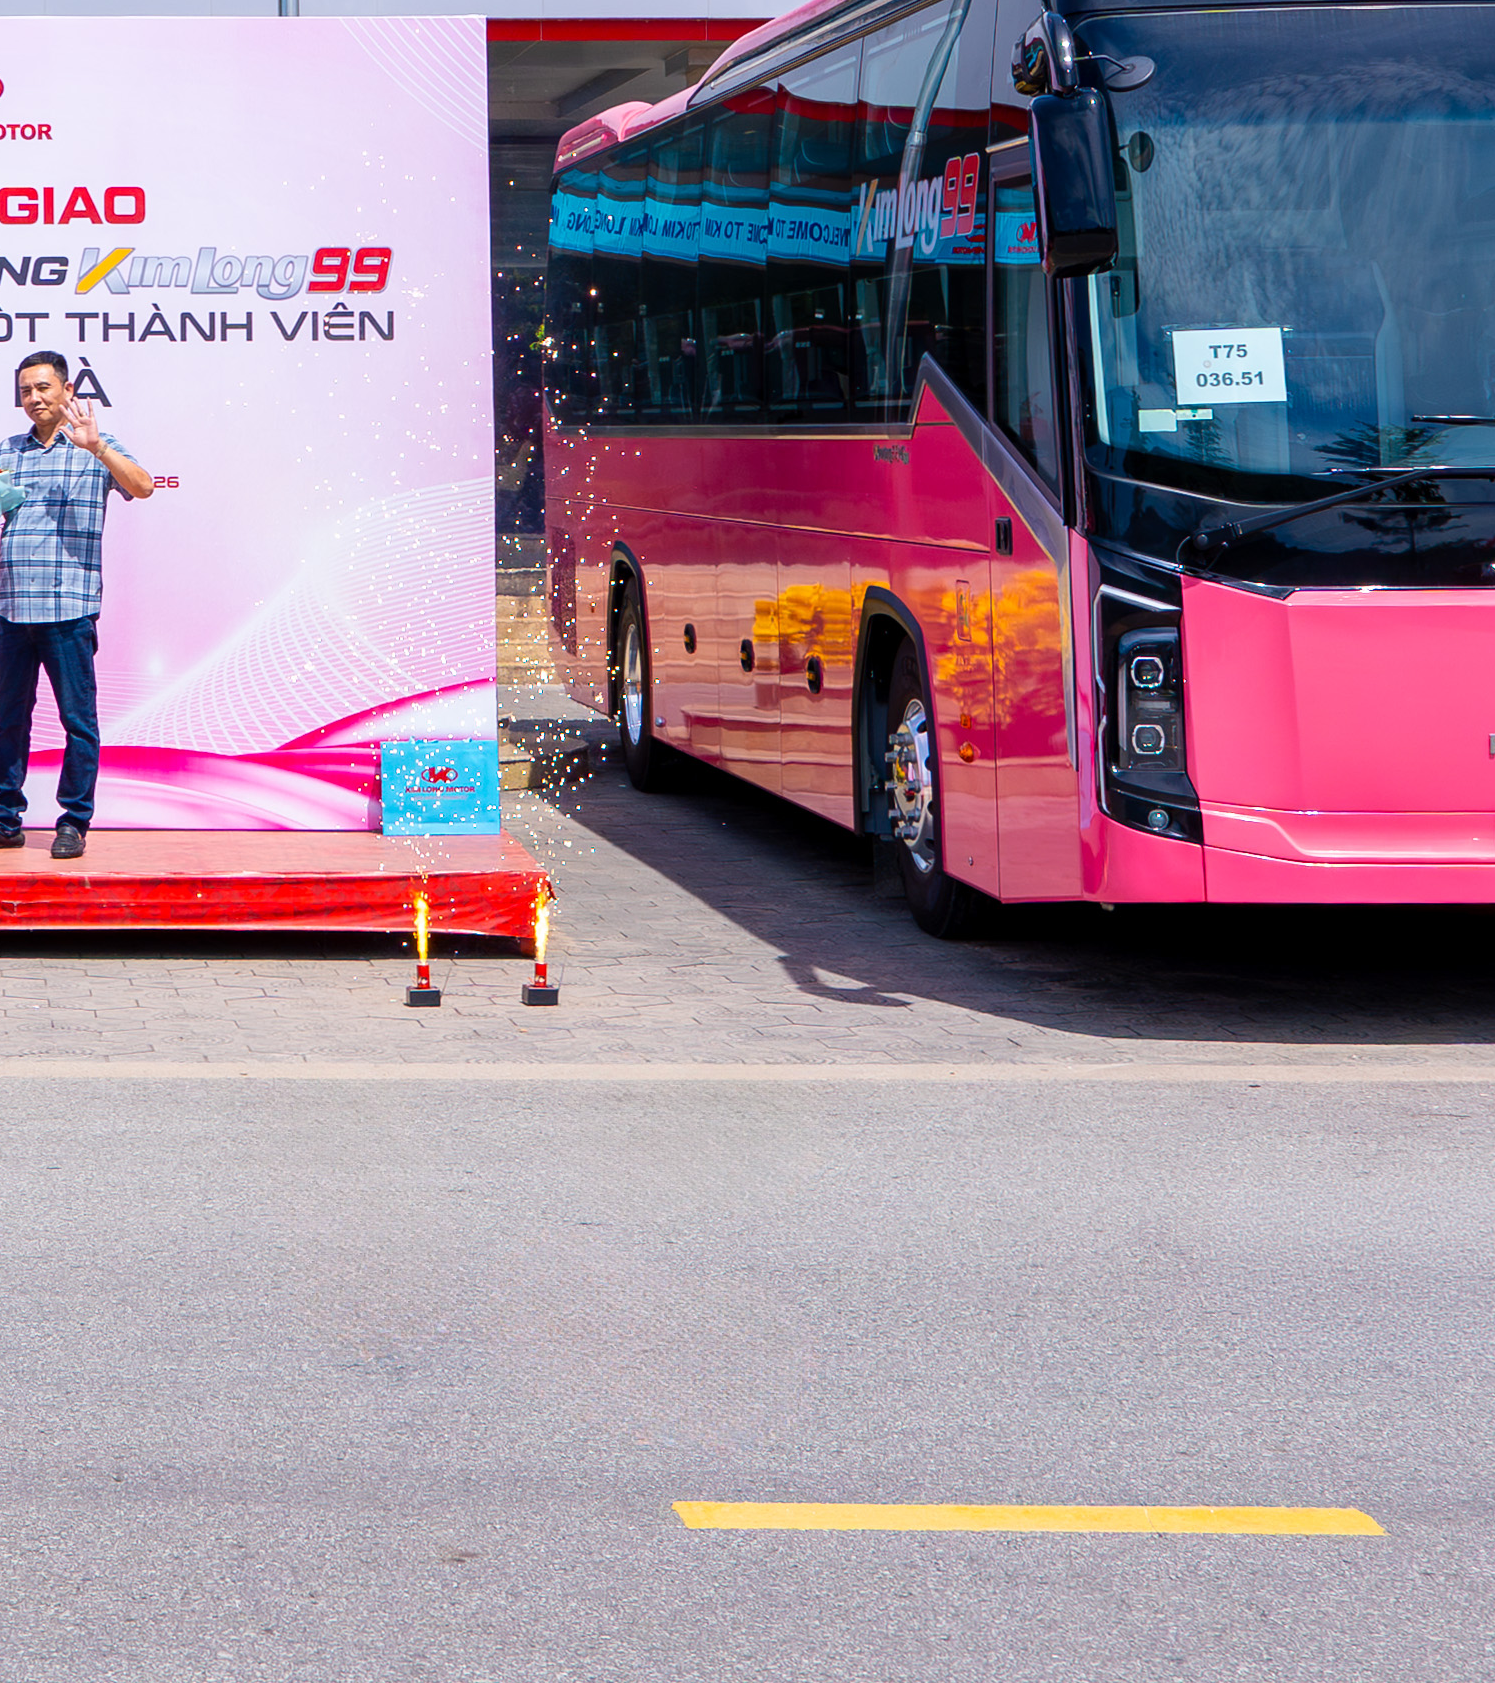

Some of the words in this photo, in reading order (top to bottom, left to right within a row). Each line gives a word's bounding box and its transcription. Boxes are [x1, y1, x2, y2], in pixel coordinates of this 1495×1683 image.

[64, 302, 253, 343] THÀNH
[269, 301, 395, 342] VIÊN
[1208, 344, 1248, 359] T75
[14, 357, 113, 408] À
[1196, 371, 1264, 387] 036.51
[153, 476, 180, 488] 26
